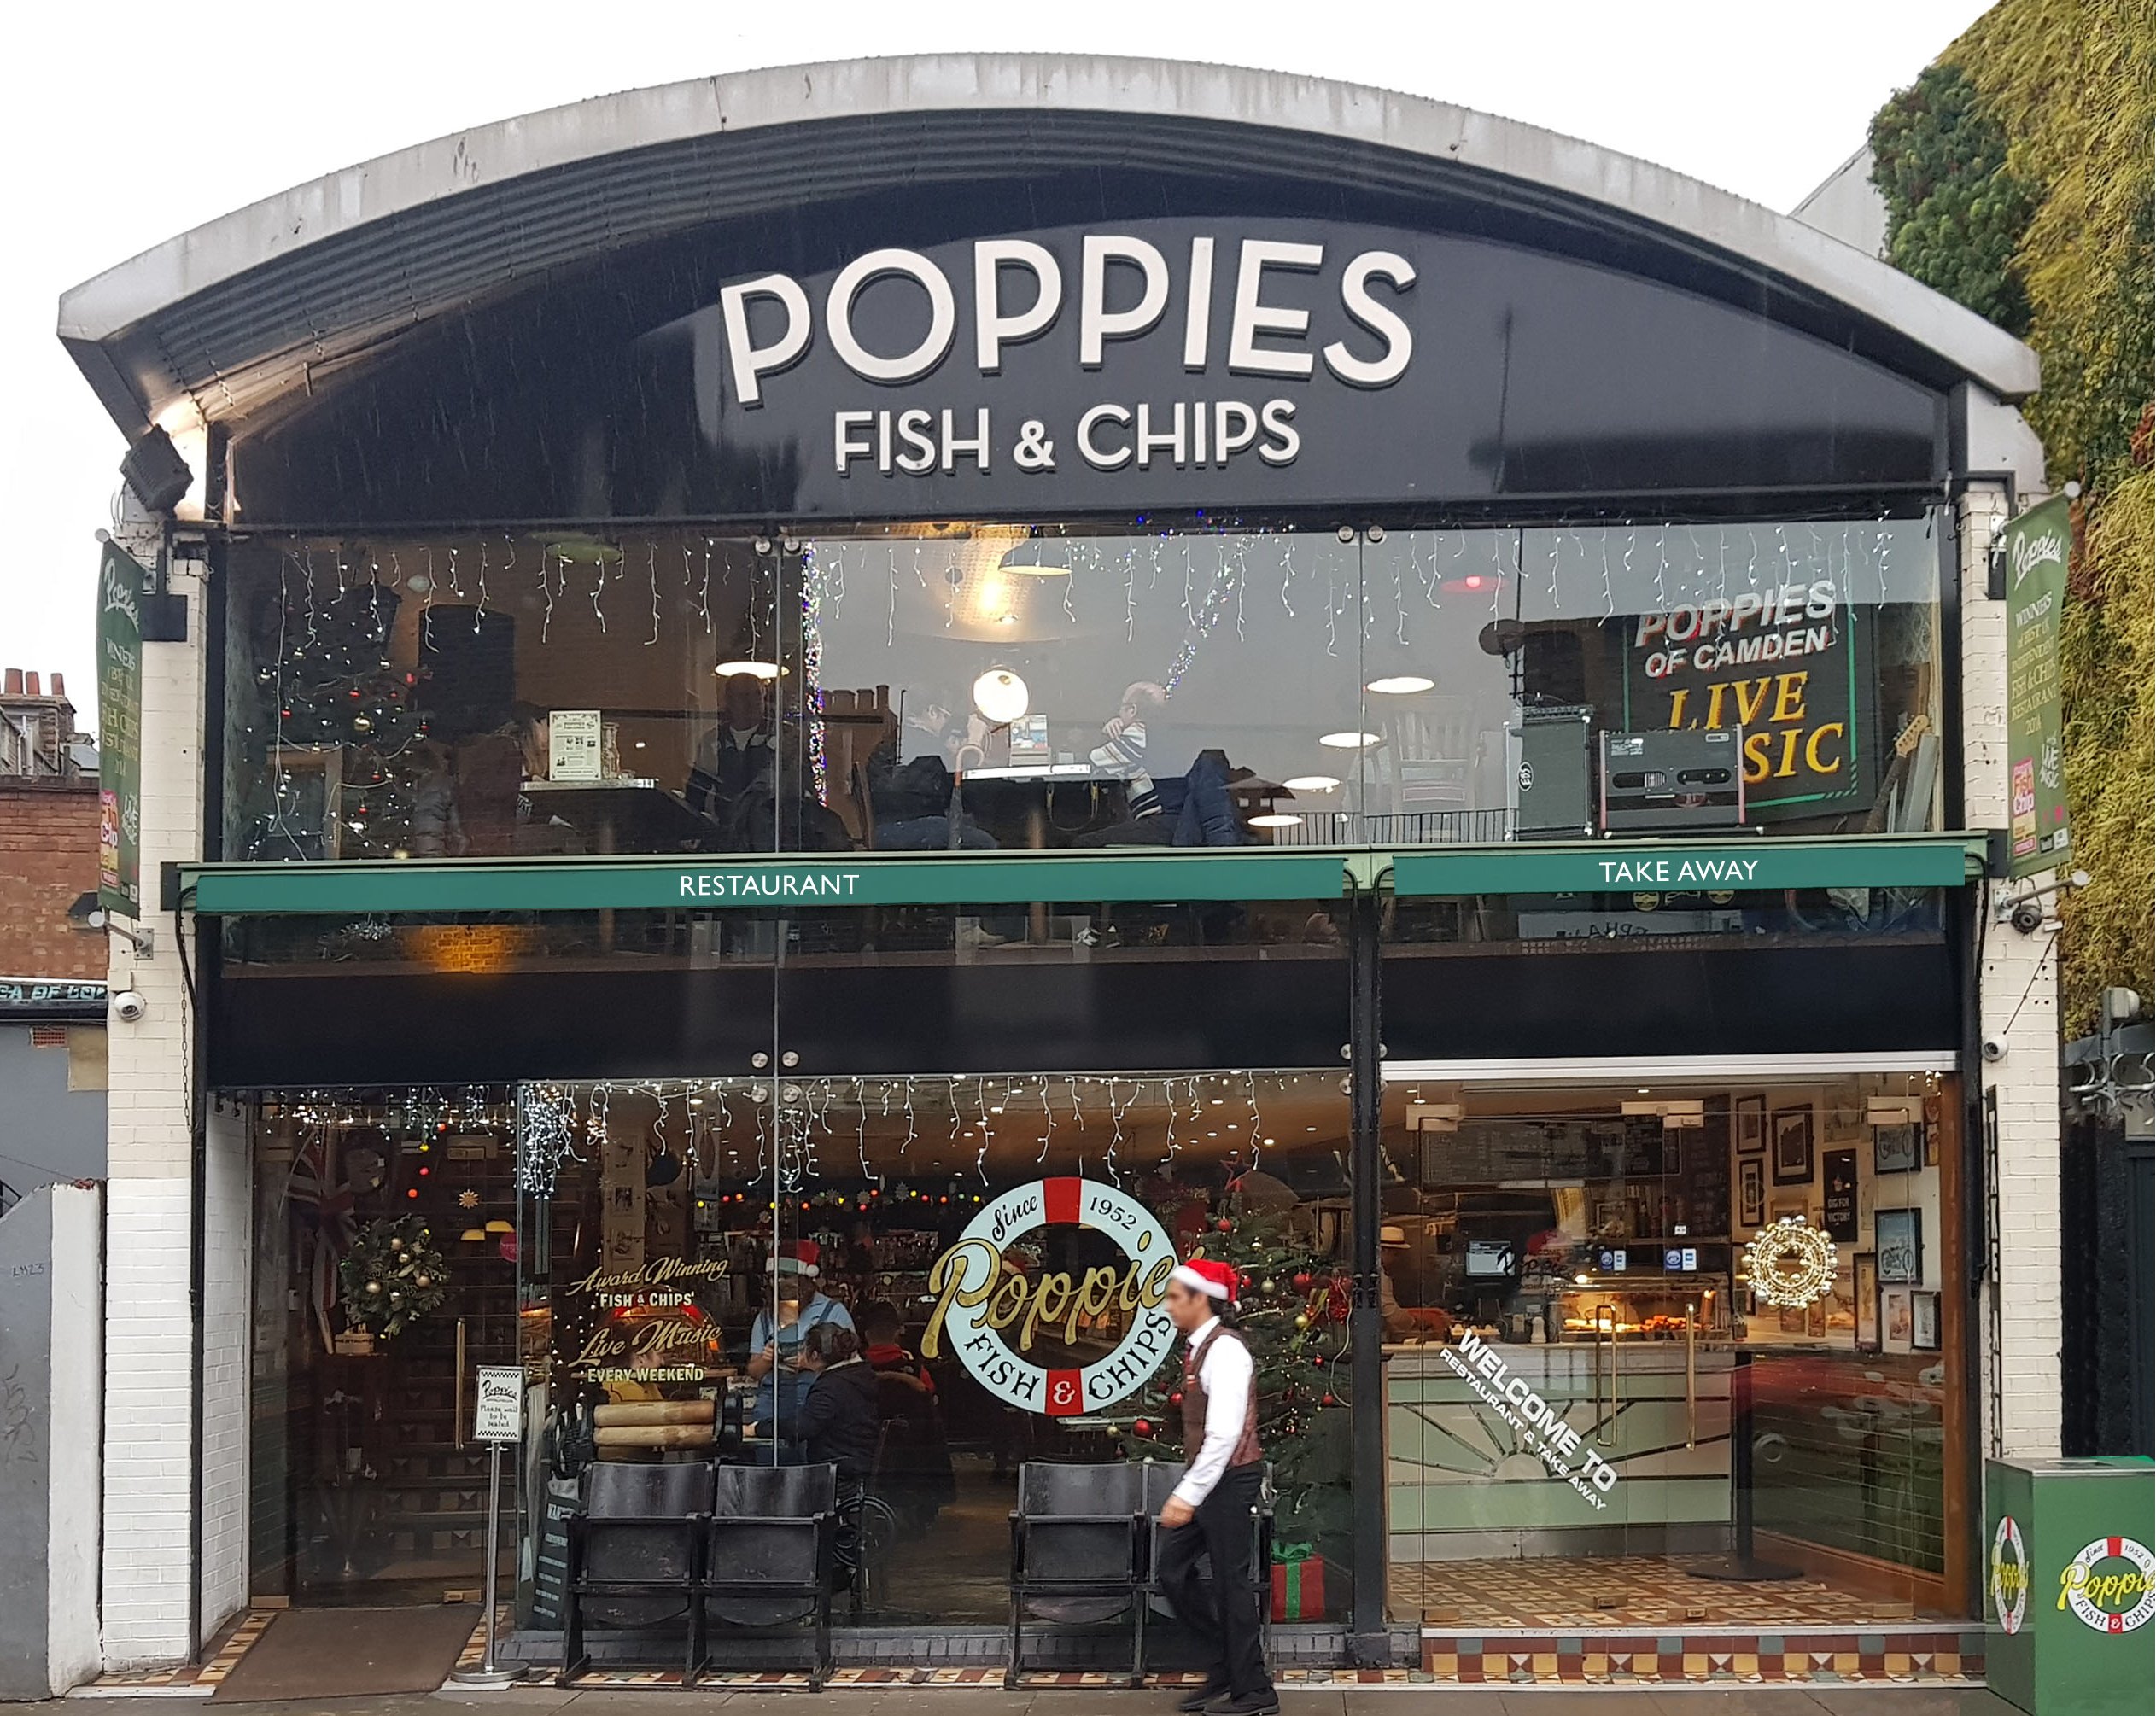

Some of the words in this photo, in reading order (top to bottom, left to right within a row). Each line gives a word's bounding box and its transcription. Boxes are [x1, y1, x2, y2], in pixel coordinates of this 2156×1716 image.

[721, 235, 1418, 408] POPPIES
[833, 408, 990, 475] FISH
[1013, 420, 1055, 471] &
[1077, 399, 1301, 470] CHIPS
[2012, 529, 2062, 591] Poppies
[1635, 580, 1836, 647] POPPIES
[1645, 649, 1686, 677] OF
[1693, 626, 1828, 670] CAMDEN
[1670, 670, 1808, 730] LIVE
[1744, 722, 1844, 784] SIC
[681, 874, 860, 896] RESTAURANT
[1598, 861, 1669, 883] TAKE
[1677, 860, 1759, 882] AWAY
[992, 1196, 1038, 1241] Since
[1090, 1196, 1137, 1230] 1952
[565, 1264, 646, 1296] Award
[646, 1257, 728, 1284] Winning
[599, 1293, 633, 1308] FISH
[637, 1293, 645, 1305] &
[920, 1230, 1205, 1359] Poppie
[568, 1328, 625, 1368] Live
[632, 1321, 722, 1355] Music
[964, 1333, 1040, 1401] FISH
[1053, 1381, 1076, 1404] &
[1088, 1311, 1171, 1400] CHIPS
[482, 1380, 517, 1400] Poppies
[587, 1368, 632, 1383] EVERY
[636, 1368, 704, 1382] WEEKEND
[1440, 1347, 1524, 1430] RESTAURANT
[1523, 1431, 1535, 1445] &
[1536, 1441, 1570, 1476] TAKE
[1569, 1475, 1607, 1511] AWAY
[1458, 1328, 1582, 1457] WELCOME
[1580, 1448, 1617, 1492] TO
[2124, 1544, 2144, 1559] 1952
[2056, 1559, 2155, 1610] Poppie
[2076, 1599, 2106, 1626] FISH
[2110, 1618, 2119, 1629] &
